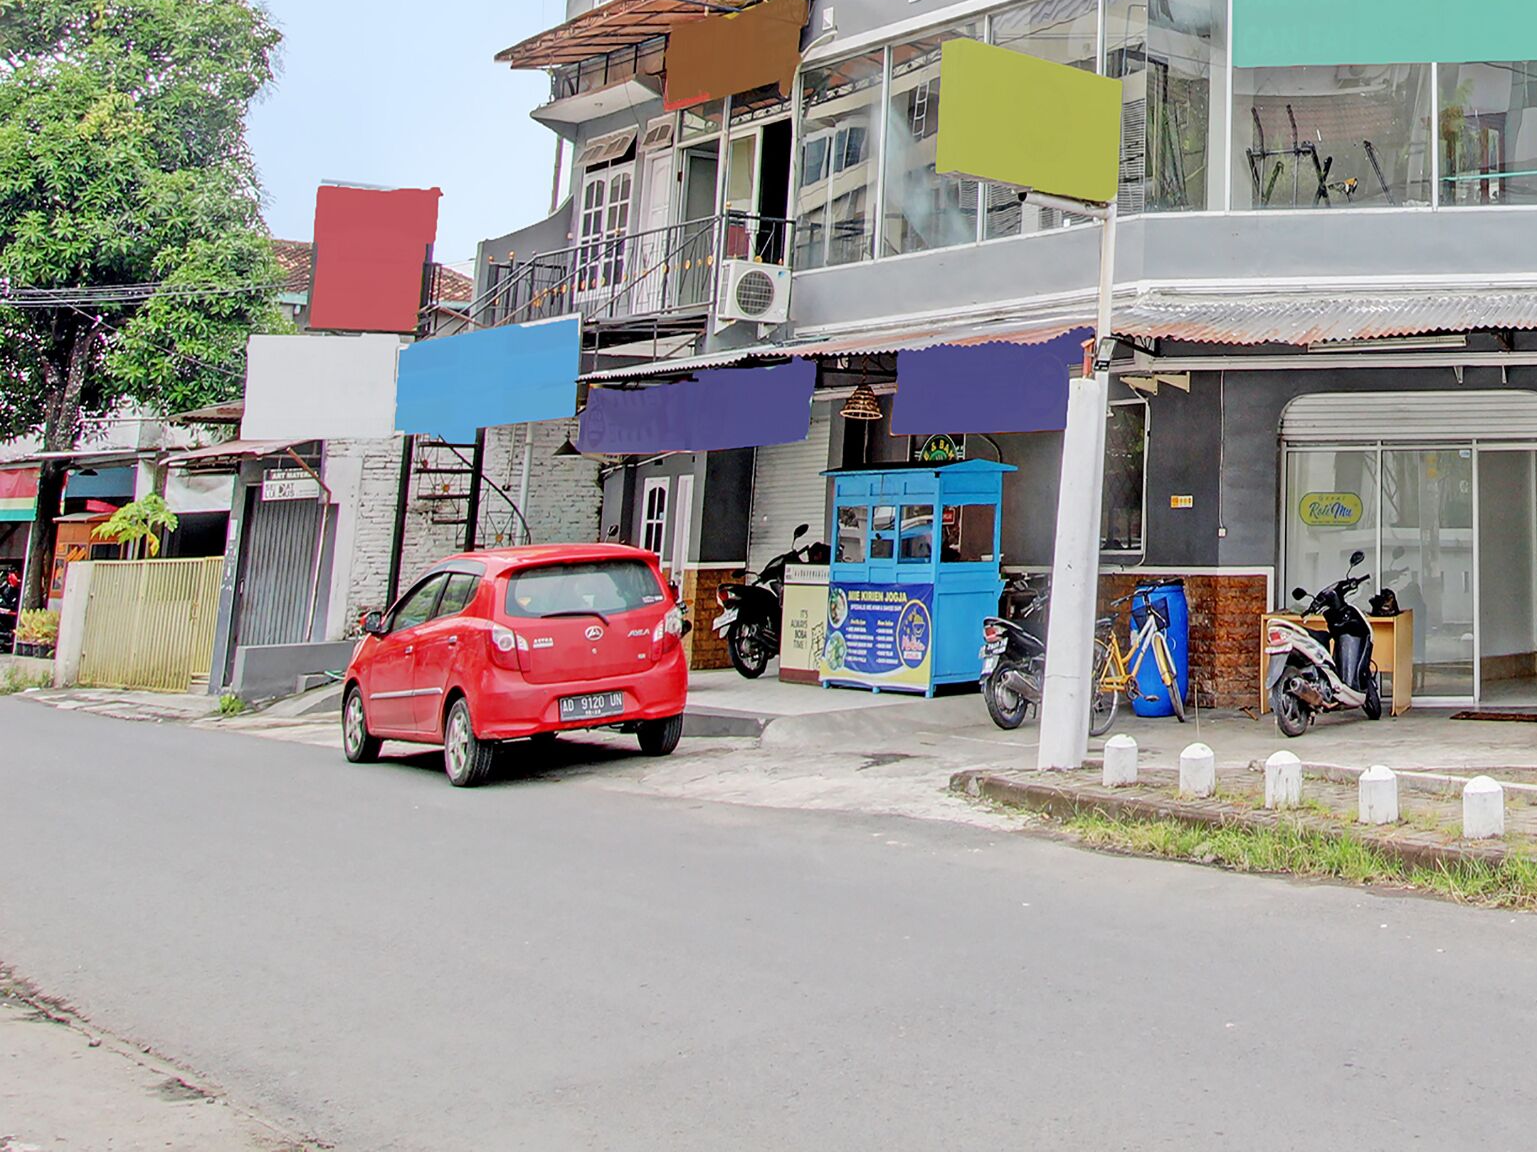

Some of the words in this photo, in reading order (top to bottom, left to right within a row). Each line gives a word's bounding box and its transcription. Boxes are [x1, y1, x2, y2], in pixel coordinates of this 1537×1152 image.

[563, 700, 574, 712] AD
[581, 695, 605, 710] 9120
[610, 693, 622, 707] UN
